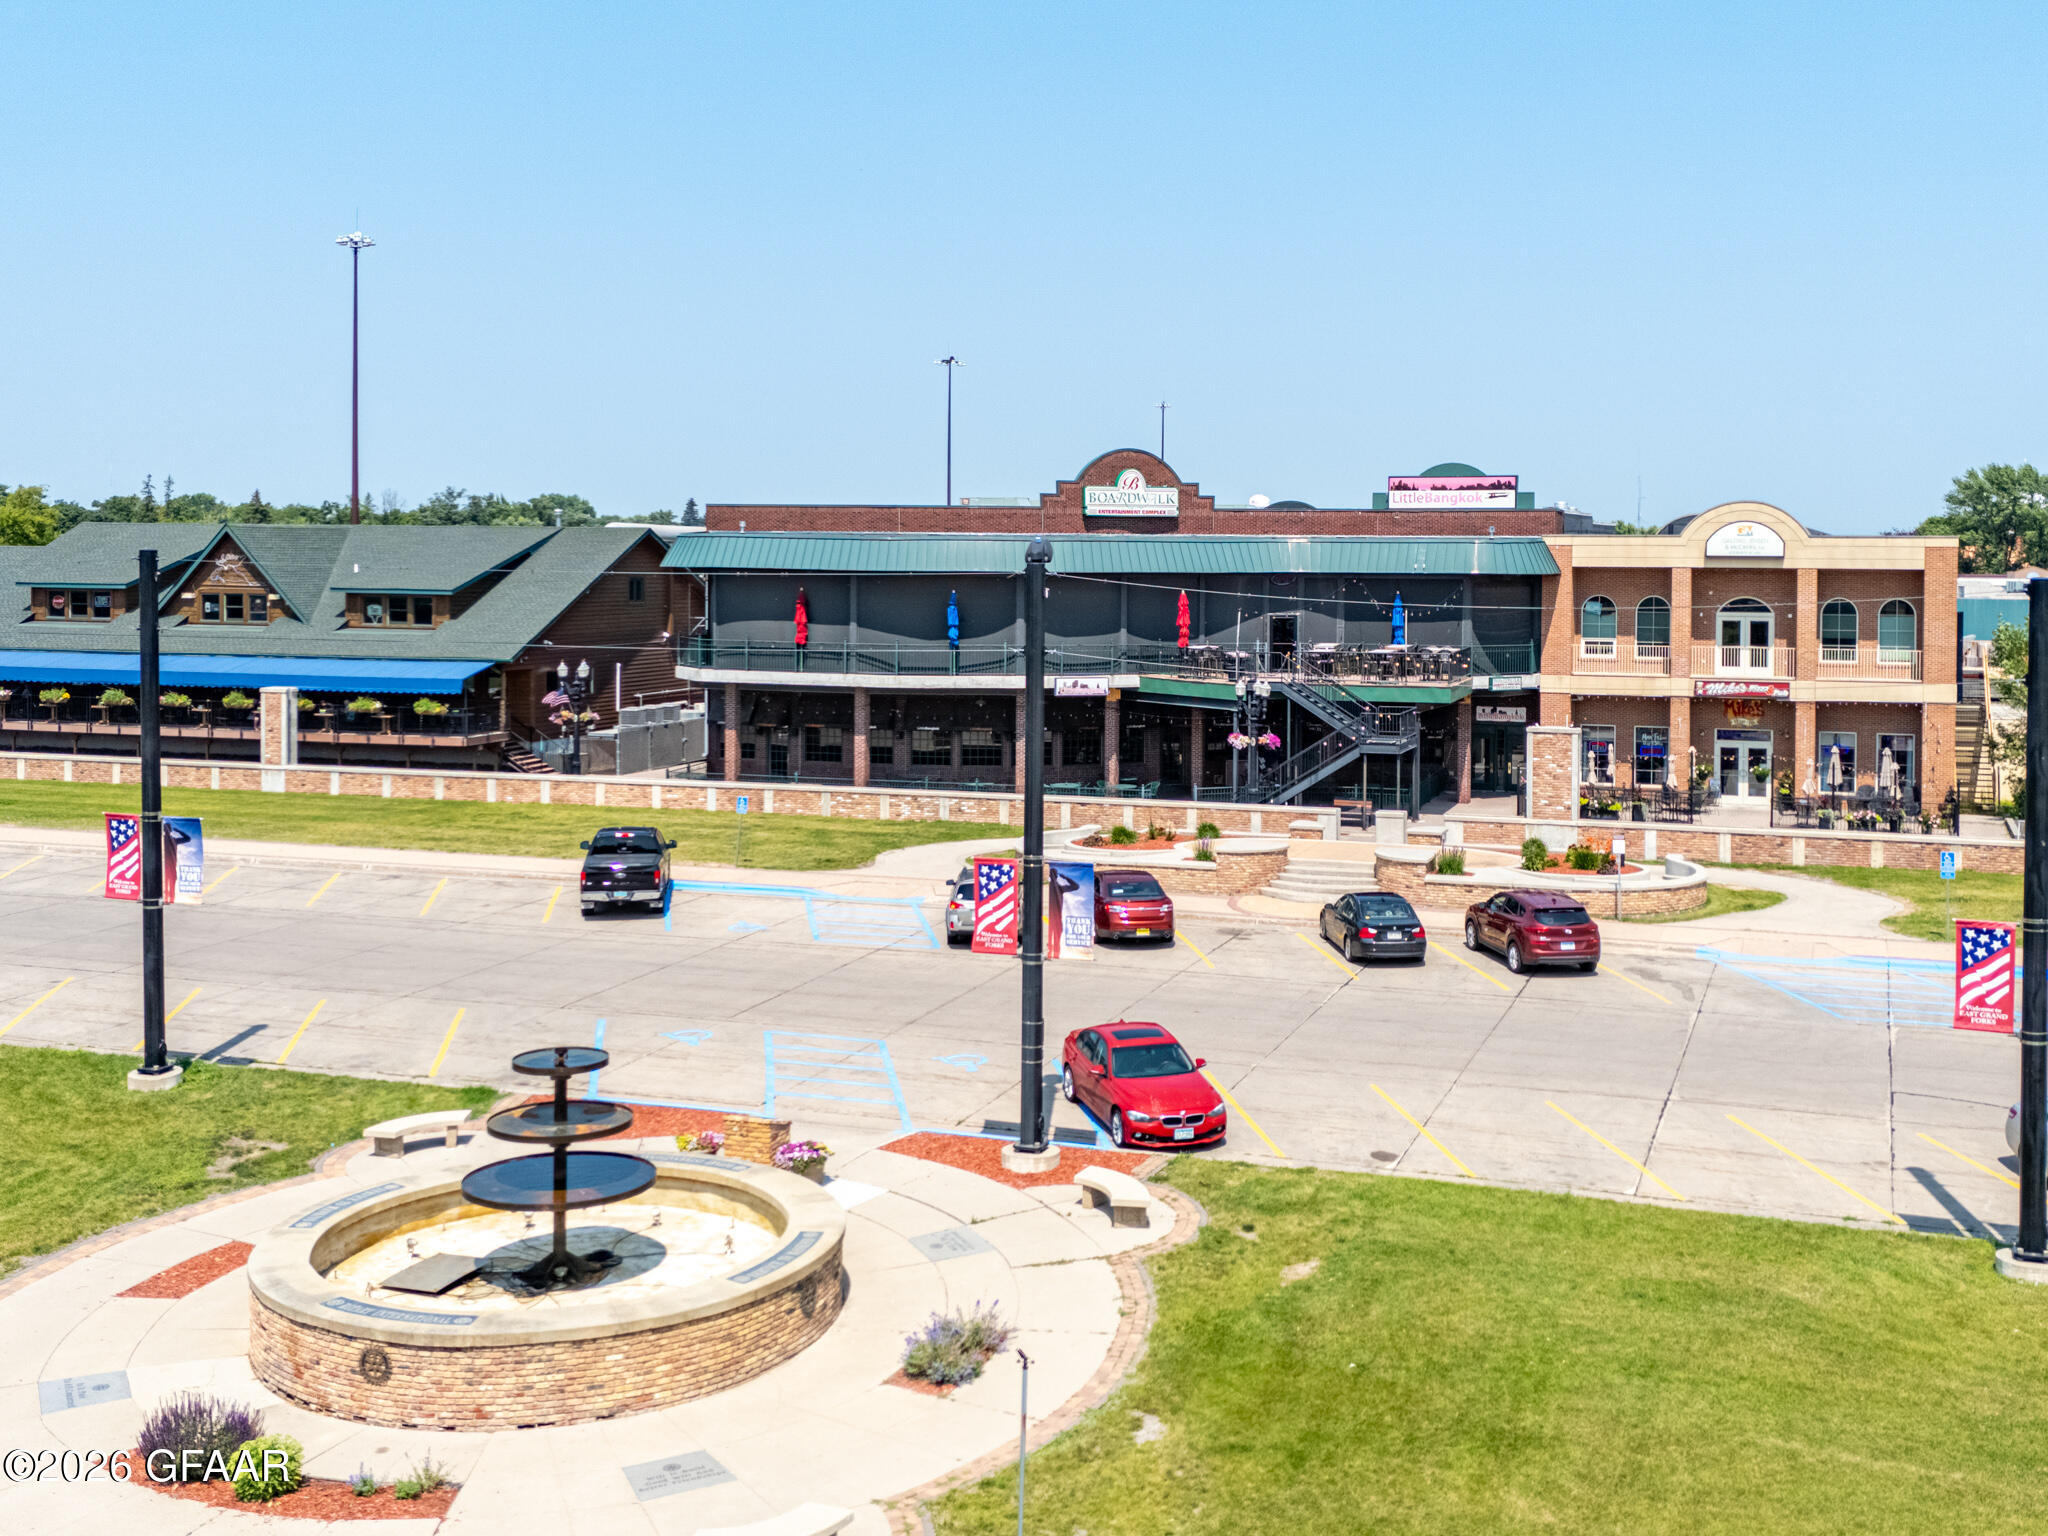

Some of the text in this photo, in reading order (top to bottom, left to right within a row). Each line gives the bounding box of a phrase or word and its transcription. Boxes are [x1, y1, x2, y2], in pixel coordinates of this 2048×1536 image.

[1392, 492, 1482, 505] LittleBangkok
[1723, 699, 1765, 717] Mike's
[1067, 924, 1090, 934] YOU
[1959, 1010, 2008, 1020] EAST GRAND
[1971, 1017, 1996, 1025] FORKS
